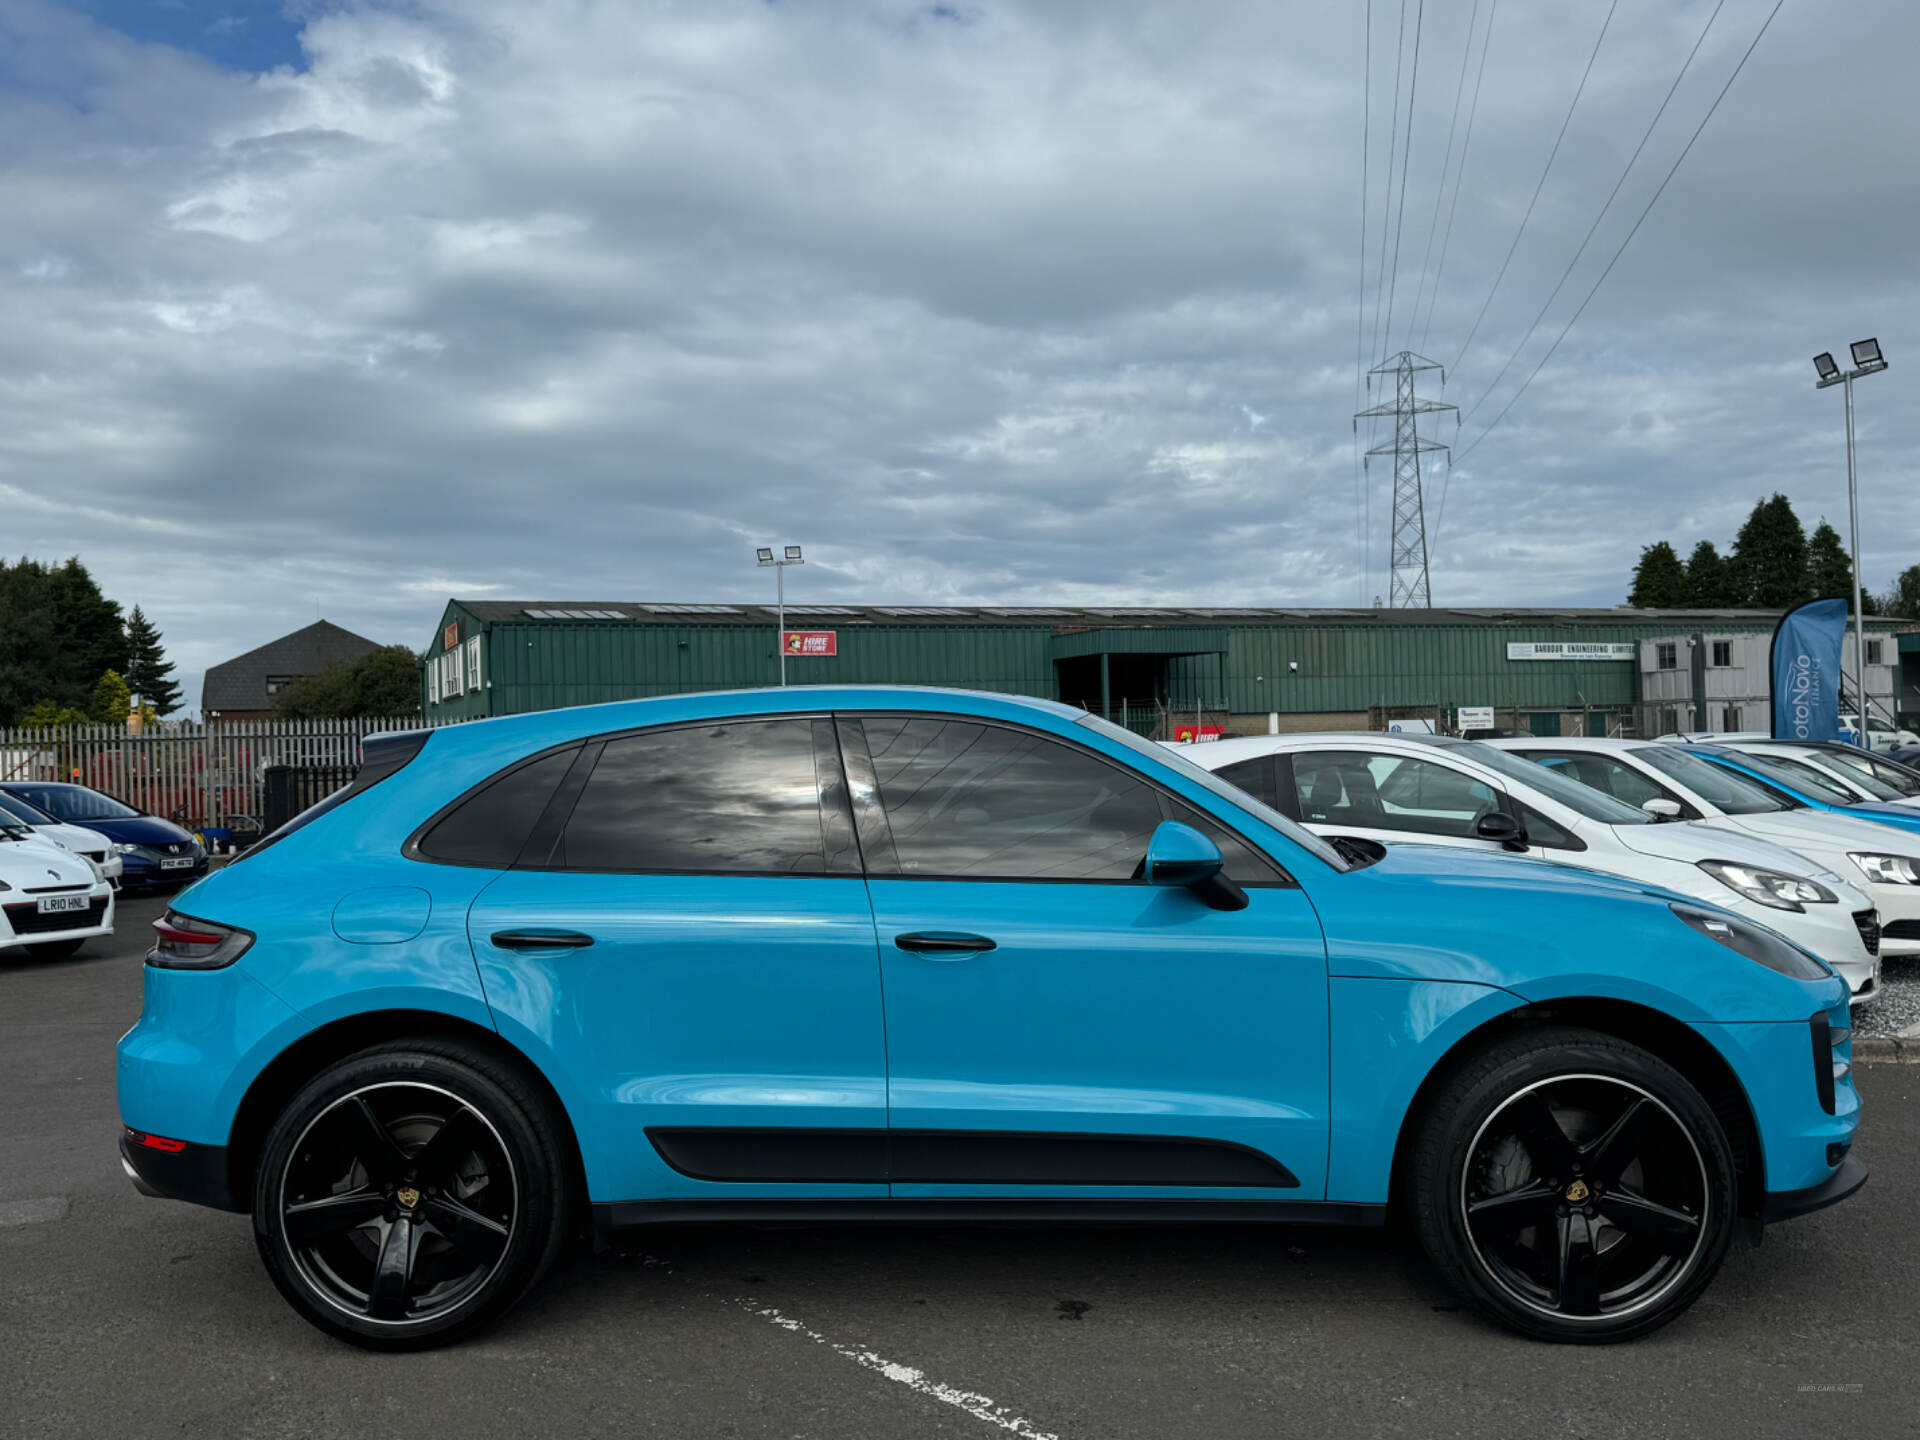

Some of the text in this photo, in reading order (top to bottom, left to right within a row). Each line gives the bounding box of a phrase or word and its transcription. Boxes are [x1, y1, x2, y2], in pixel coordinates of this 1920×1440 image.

[804, 637, 828, 645] HIRE
[1567, 644, 1608, 653] ENGINEERING
[1612, 645, 1634, 653] LIMITE
[1792, 655, 1811, 739] otoNovo
[43, 898, 67, 911] LR10
